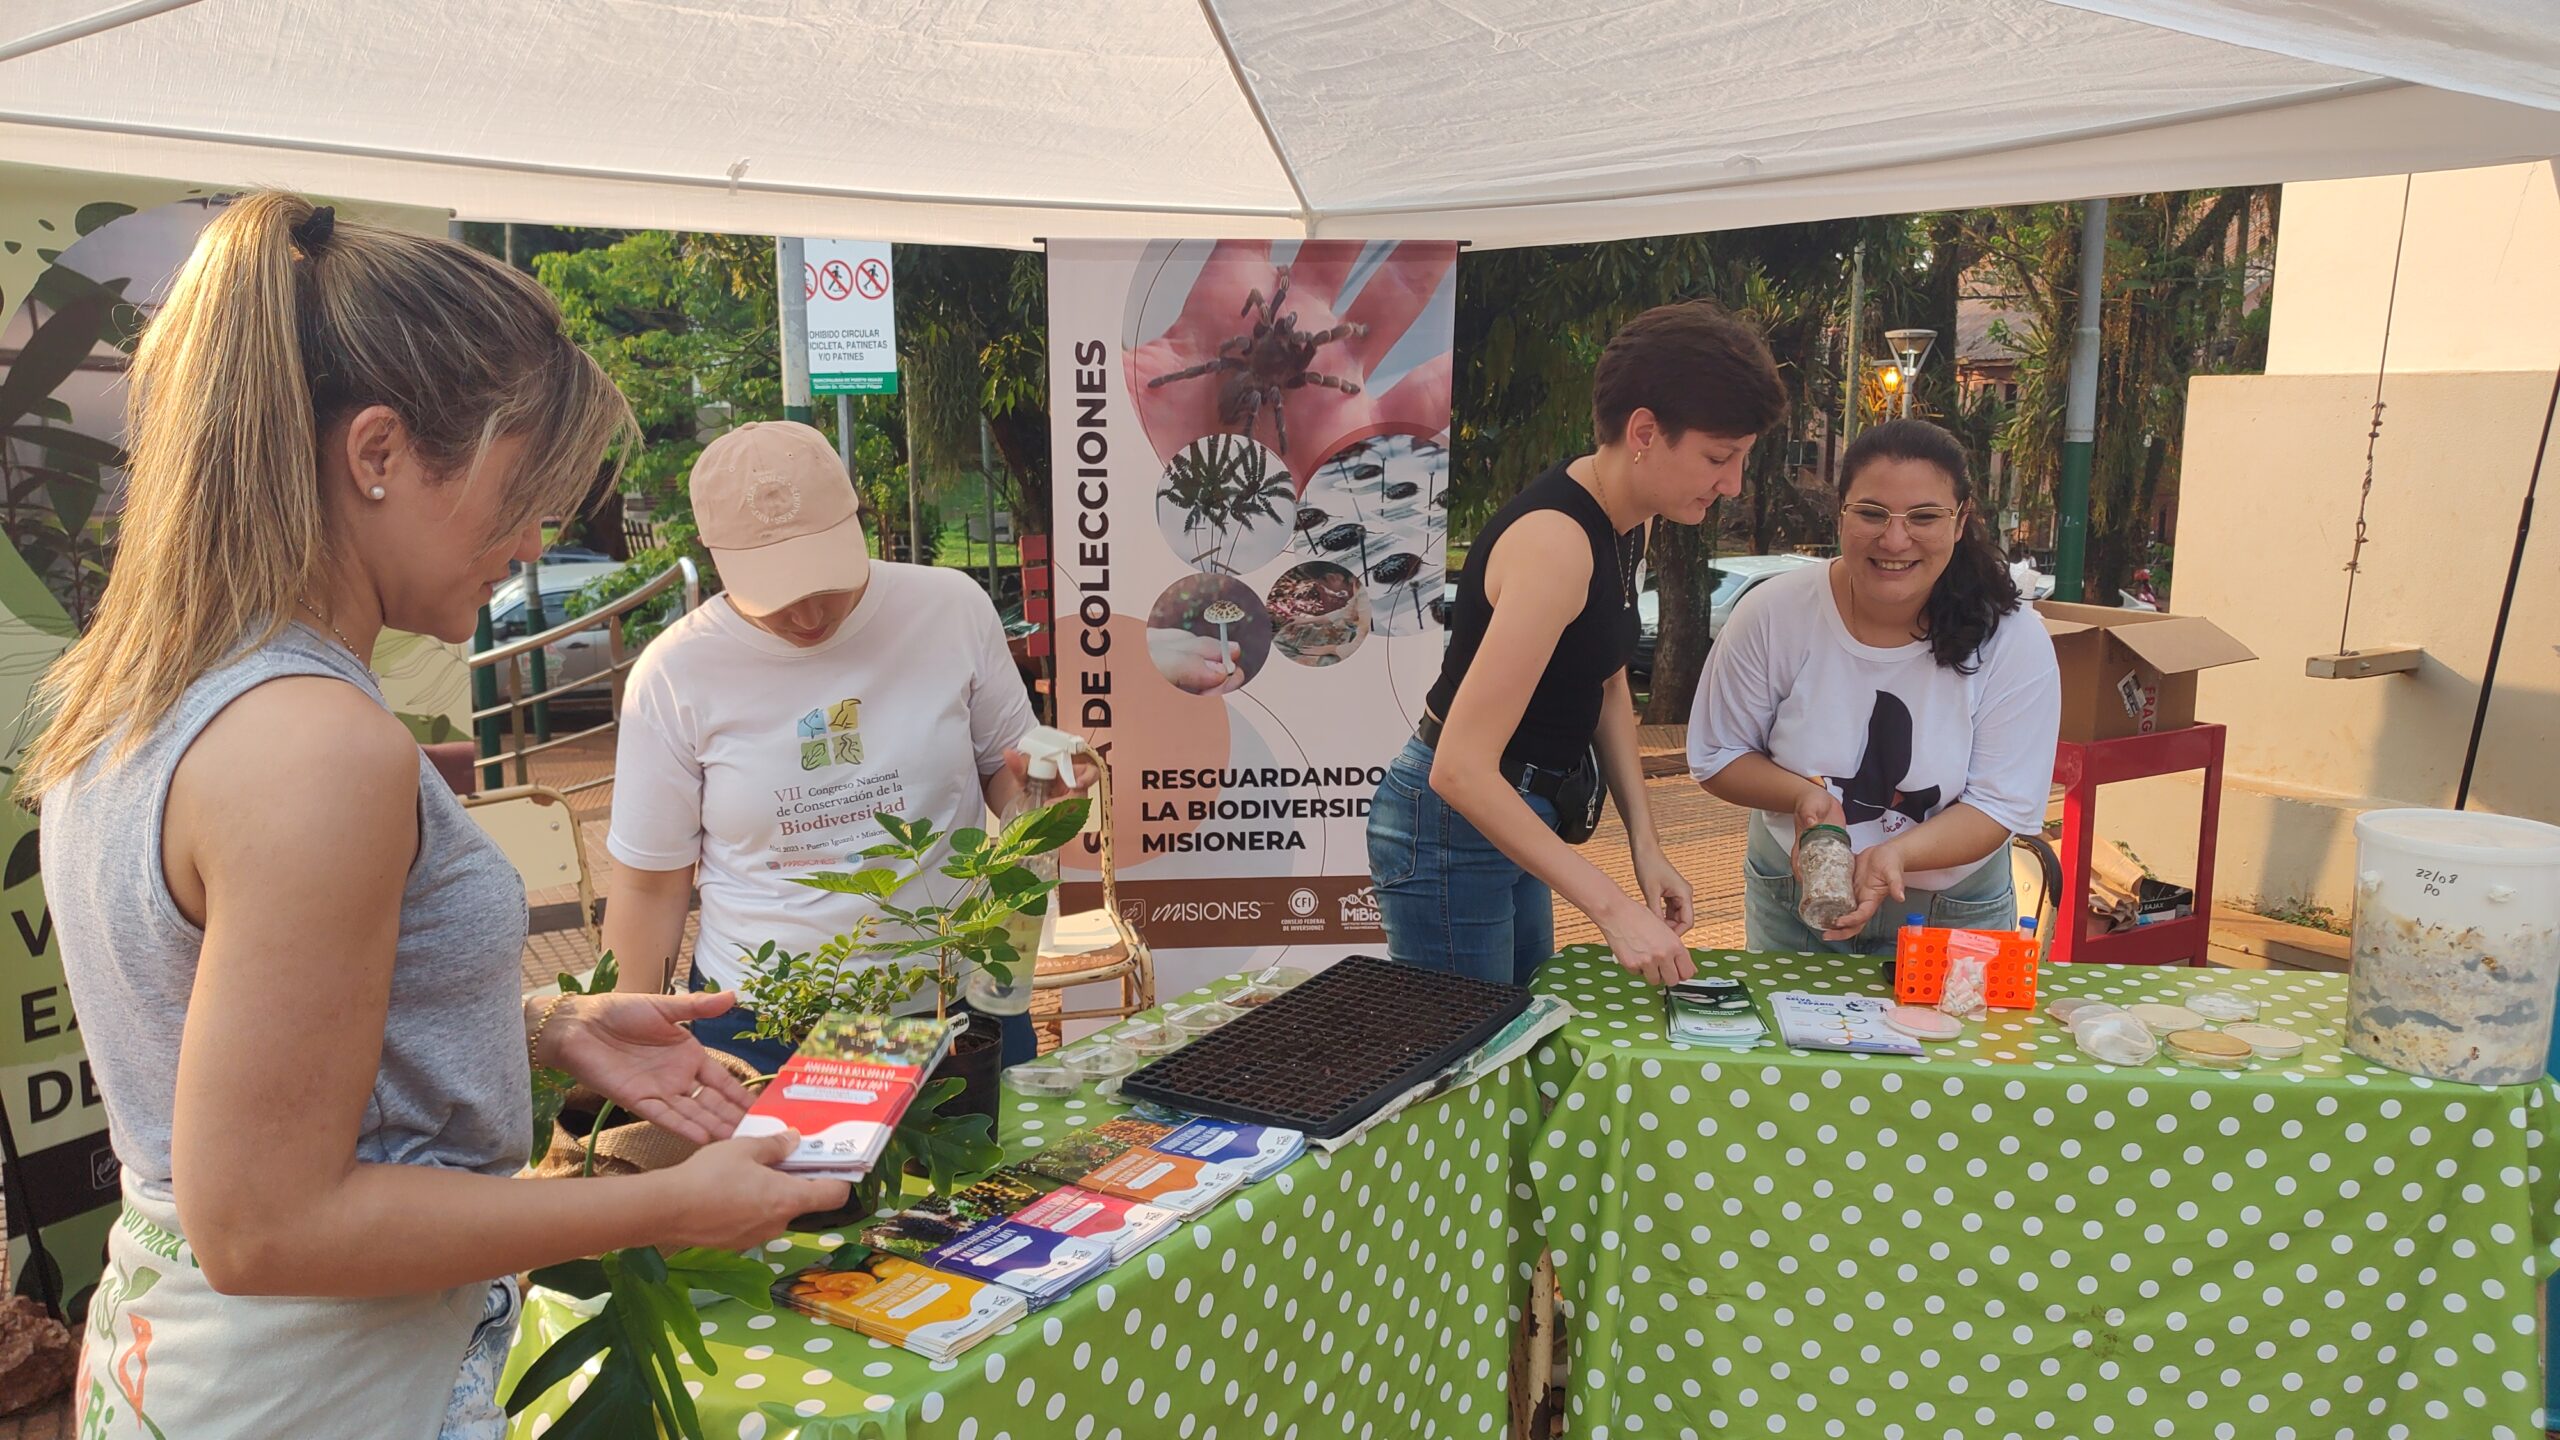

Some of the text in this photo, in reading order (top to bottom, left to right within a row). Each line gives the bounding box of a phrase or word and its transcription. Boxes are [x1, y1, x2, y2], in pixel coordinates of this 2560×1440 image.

[809, 329, 880, 339] OHIBIDO CIRCULAR
[809, 340, 889, 350] ICICLETA, PATINETAS
[818, 352, 865, 361] Y/O PATINES
[1075, 340, 1110, 660] COLECCIONES
[1081, 671, 1112, 728] DE
[2142, 686, 2156, 732] FRAG
[774, 769, 899, 802] VII Congreso Nacional
[1141, 765, 1388, 790] RESGUARDANDO
[776, 782, 903, 817] de Conservación de la
[1142, 798, 1372, 822] LA BIODIVERSID
[779, 796, 906, 836] Biodiversidad
[806, 841, 829, 851] Puerto
[1142, 830, 1306, 853] MISIONERA
[2415, 868, 2458, 884] 22/08
[1151, 901, 1262, 922] MISIONES
[1294, 897, 1312, 908] CFI
[134, 1222, 186, 1262] PARA
